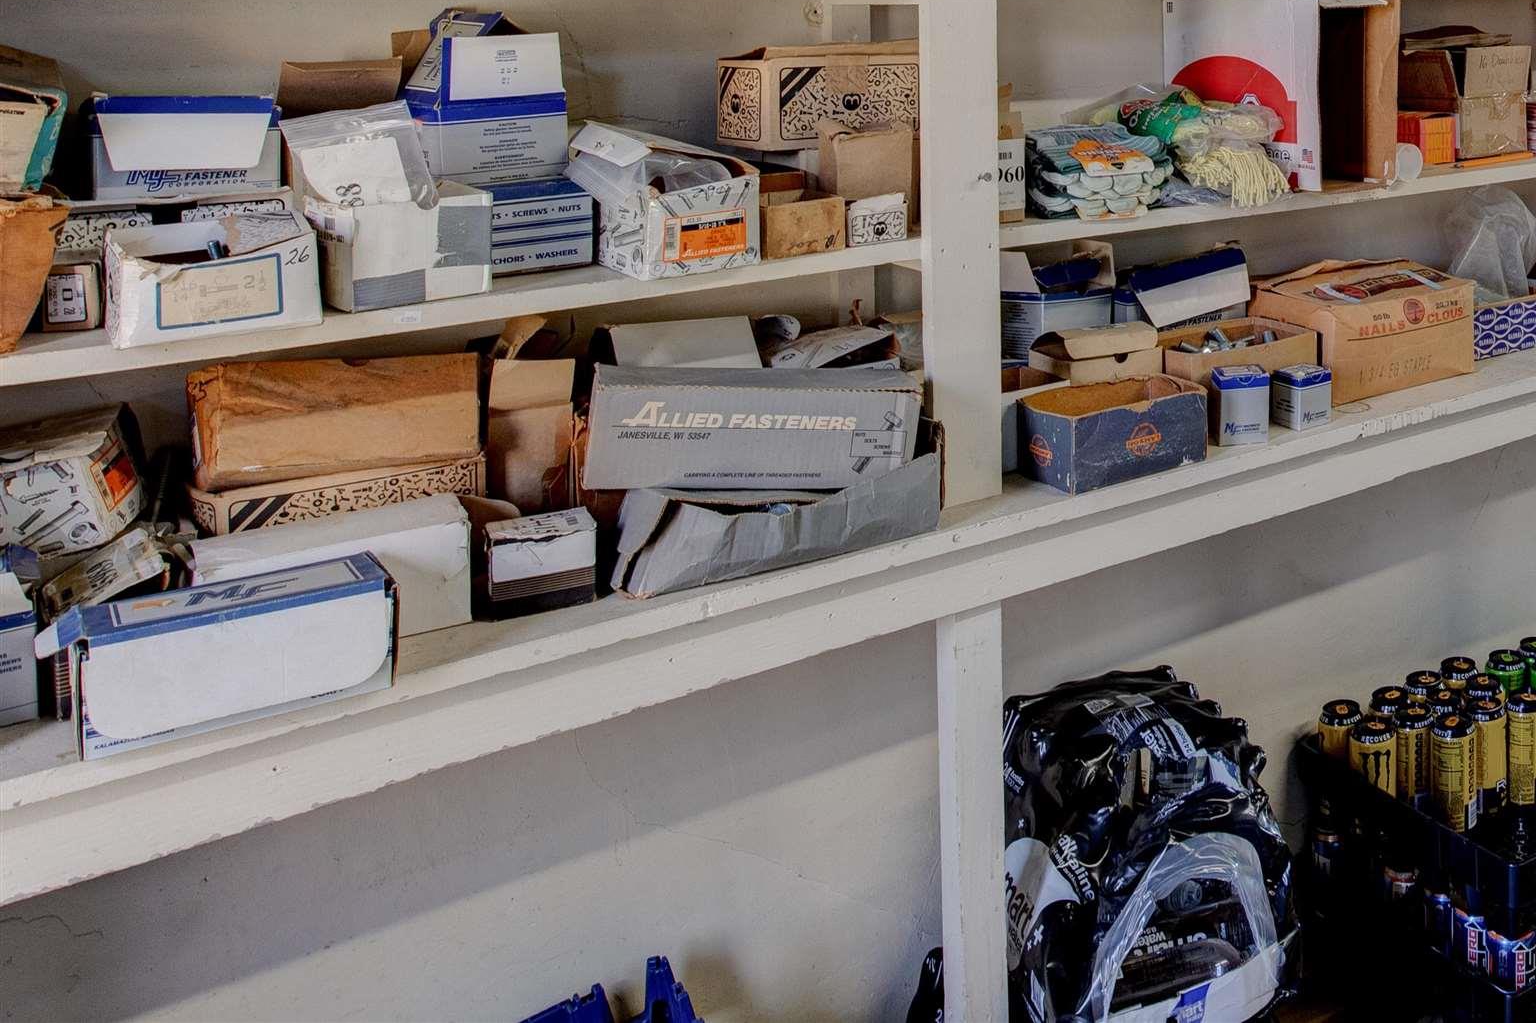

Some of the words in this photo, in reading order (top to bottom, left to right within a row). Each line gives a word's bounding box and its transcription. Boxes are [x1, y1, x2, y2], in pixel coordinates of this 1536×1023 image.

[185, 169, 248, 181] FASTENER
[168, 178, 247, 189] CORPORATION
[511, 207, 549, 219] SCREWS
[558, 204, 582, 213] NUTS
[285, 245, 310, 267] 26
[491, 254, 526, 266] CHORS
[535, 248, 579, 261] WASHERS
[1426, 306, 1465, 324] CLOUS
[1359, 319, 1407, 338] NAILS
[622, 401, 724, 430] ALLIED
[728, 413, 857, 431] FASTENERS
[617, 431, 672, 441] JANESVILLE,
[673, 432, 685, 440] WI
[687, 432, 711, 441] 53547
[1451, 669, 1478, 680] RECOVER
[1360, 732, 1391, 745] RECOVER
[1057, 833, 1096, 902] alkaline
